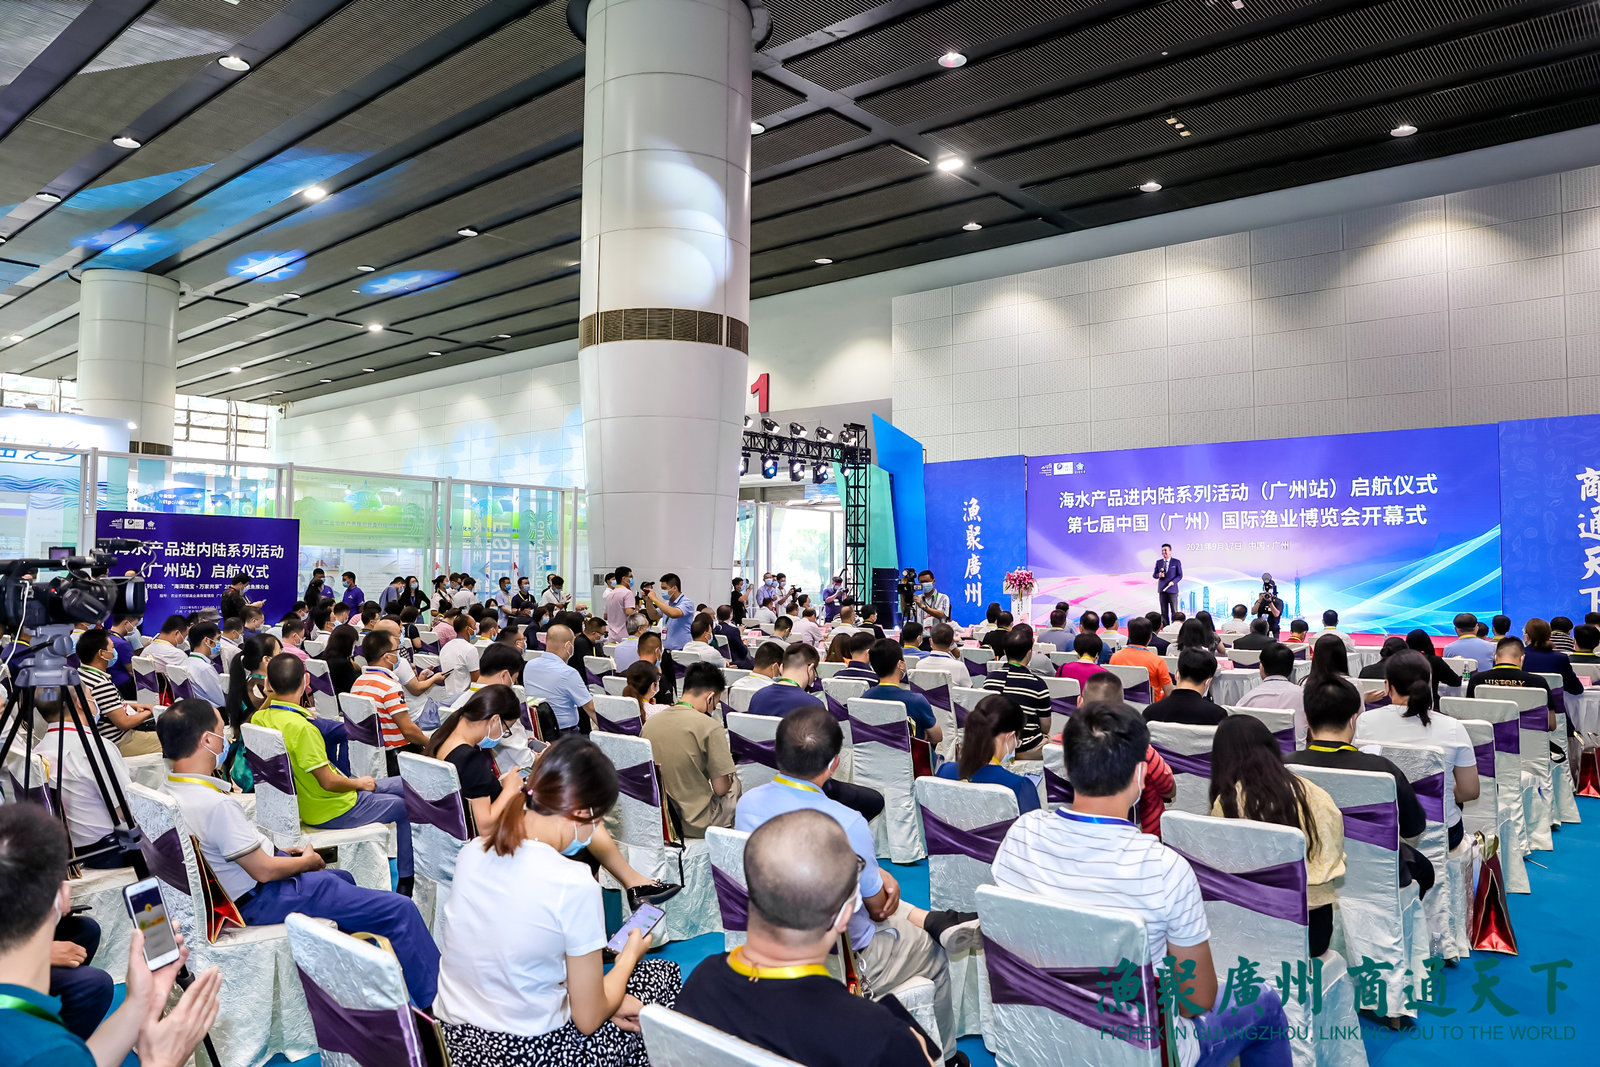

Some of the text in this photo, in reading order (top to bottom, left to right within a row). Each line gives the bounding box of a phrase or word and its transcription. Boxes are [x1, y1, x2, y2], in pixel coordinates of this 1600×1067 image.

[751, 373, 769, 413] 1
[1059, 473, 1438, 509] 海水产品进内陆系列活动（广州站）启航仪式
[1067, 504, 1428, 534] 第七届中国（广州）国际渔业博览会开幕式
[962, 497, 984, 607] 漁聚廣州
[1484, 678, 1526, 687] HISTORY
